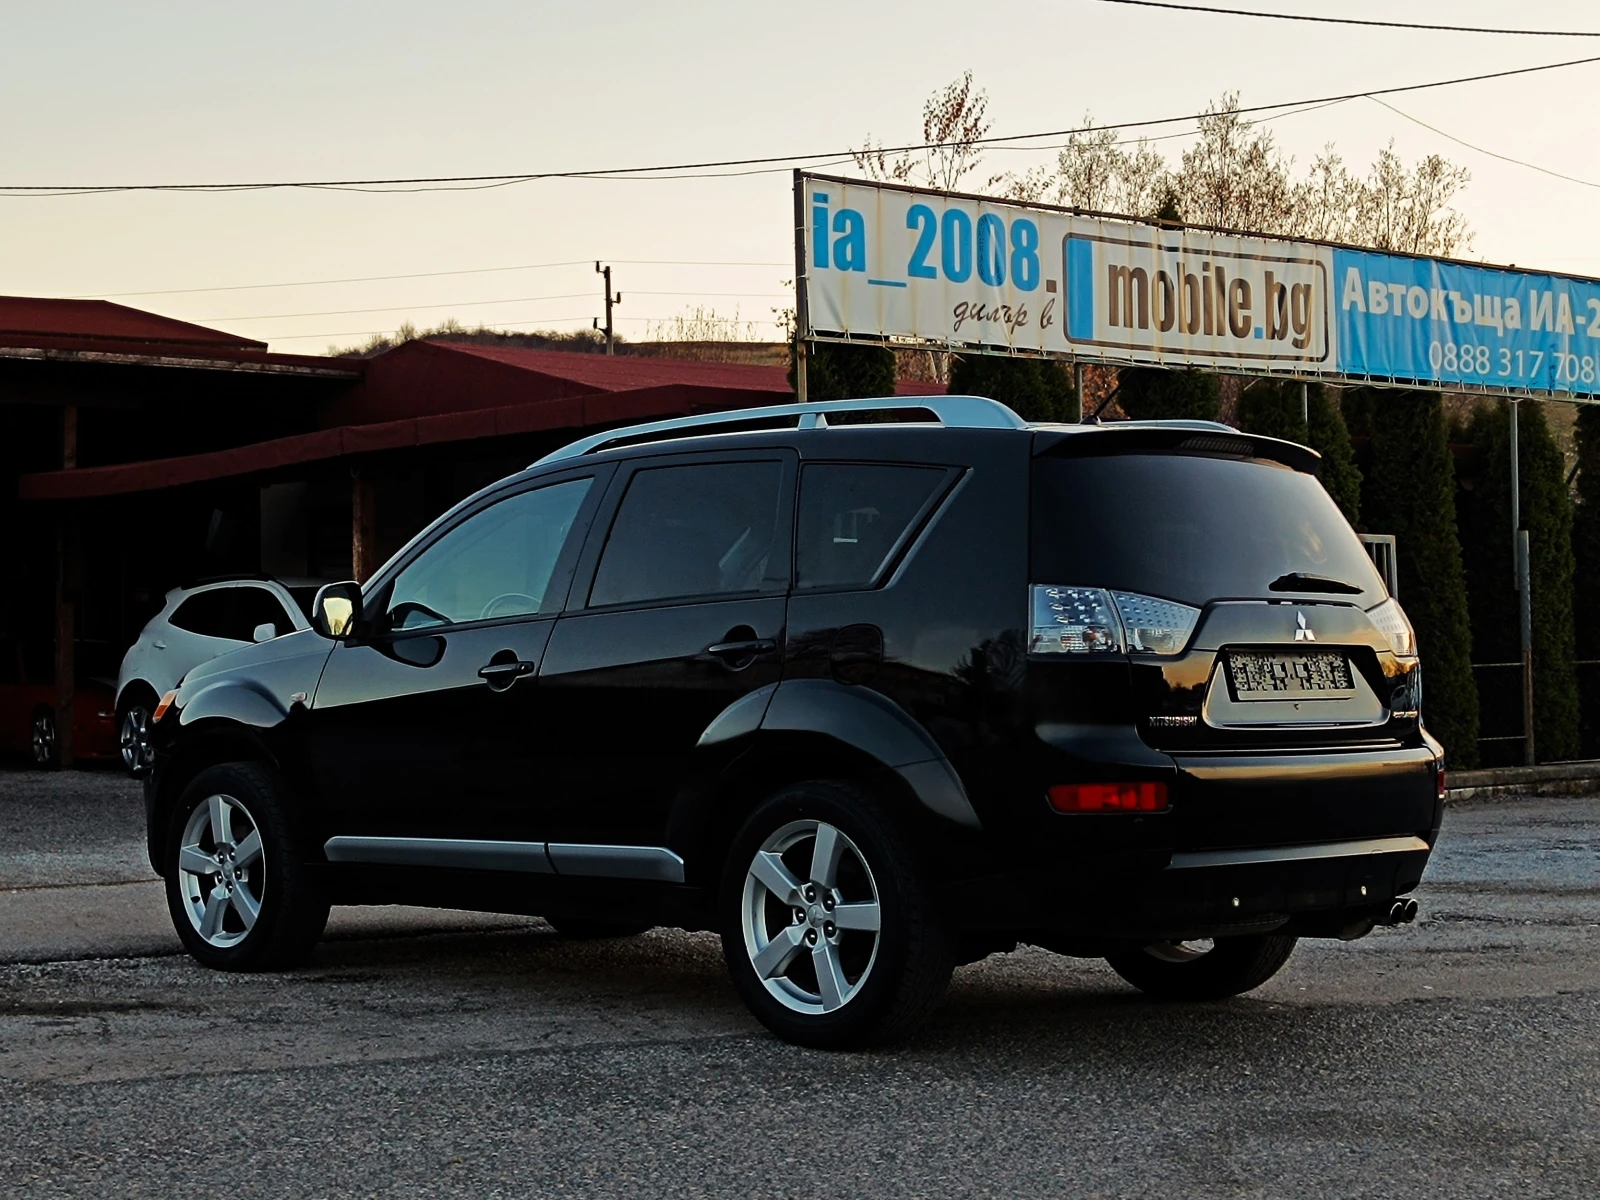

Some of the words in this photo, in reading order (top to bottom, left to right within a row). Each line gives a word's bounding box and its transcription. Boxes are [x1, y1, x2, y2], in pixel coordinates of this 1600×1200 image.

[953, 300, 1029, 335] дилър
[1108, 261, 1313, 350] mobile.bg
[1342, 266, 1522, 338] Автокъща
[1428, 340, 1491, 375] 0888
[1498, 347, 1544, 378] 317
[1553, 351, 1595, 384] 708
[1148, 715, 1198, 727] MITSUBISHI
